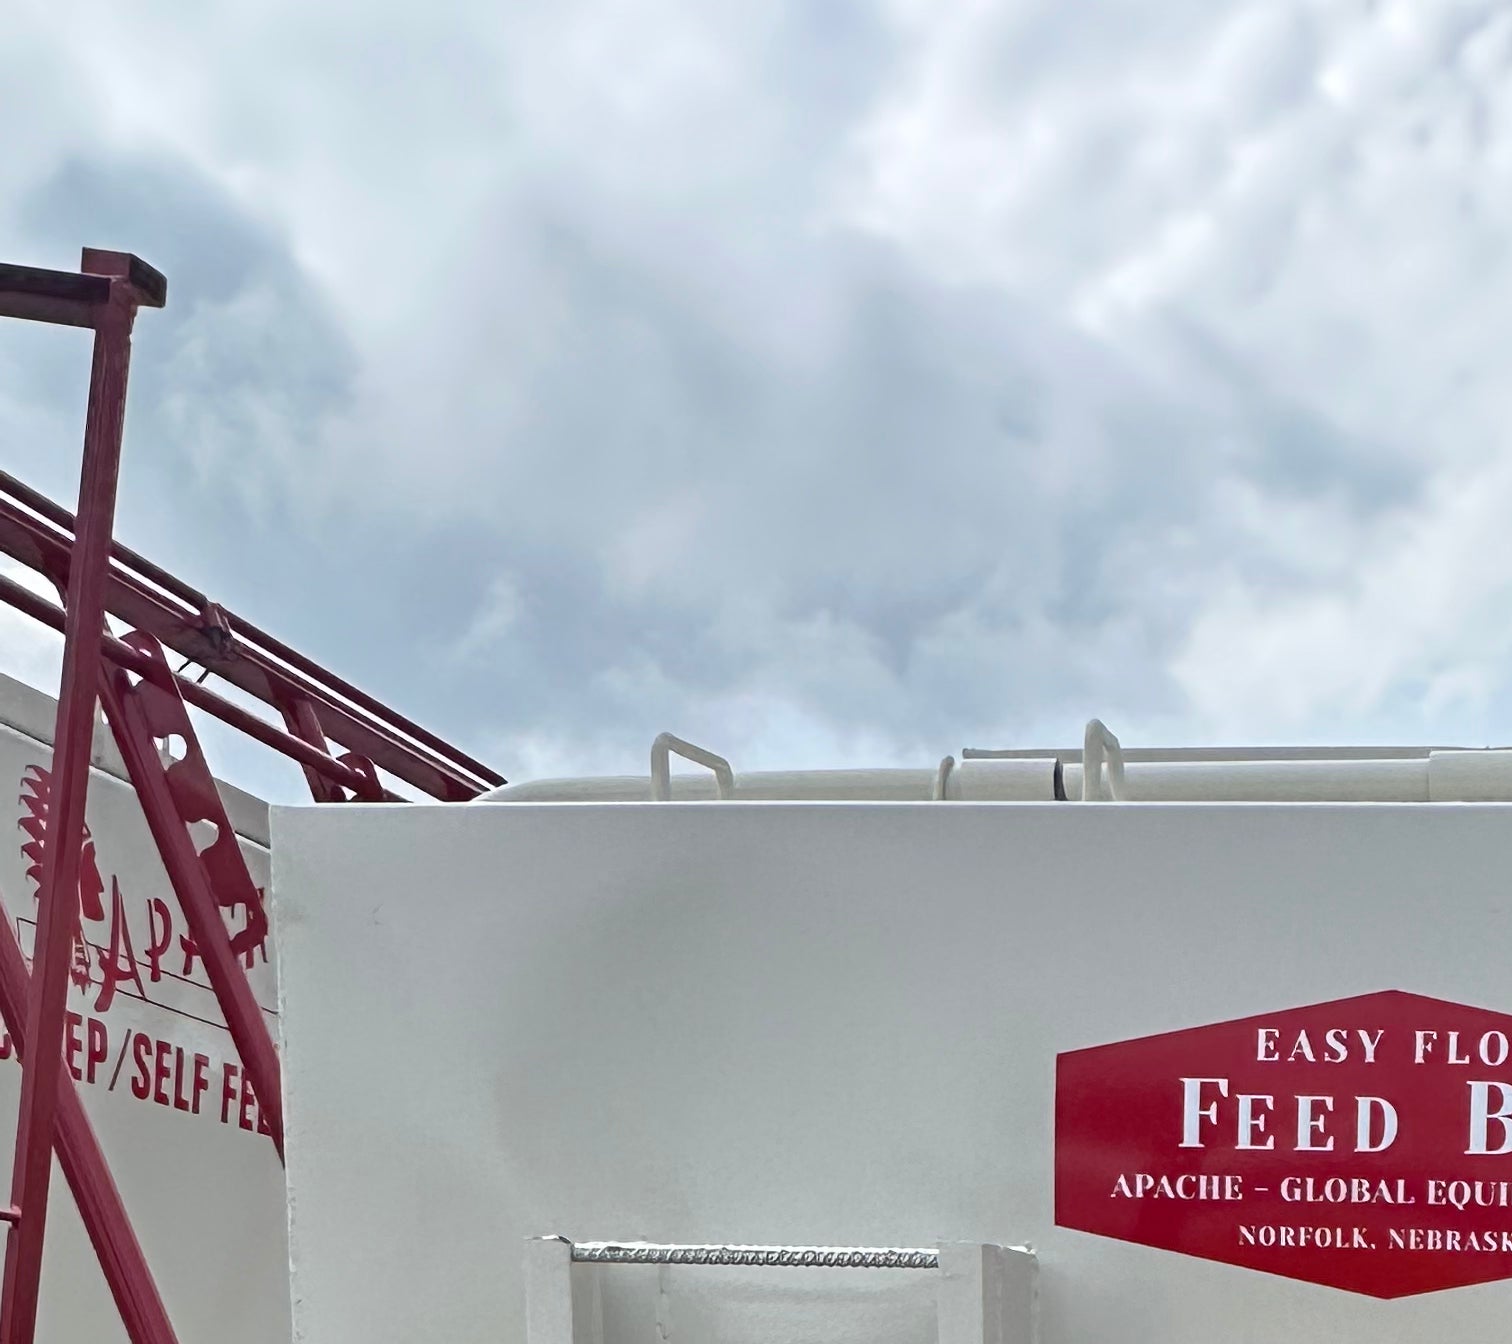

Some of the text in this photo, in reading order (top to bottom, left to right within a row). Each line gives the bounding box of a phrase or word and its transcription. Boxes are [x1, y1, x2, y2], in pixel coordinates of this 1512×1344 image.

[1257, 1028, 1384, 1064] EASY
[1110, 1173, 1243, 1200] APACHE
[1280, 1176, 1415, 1204] GLOBAL
[1239, 1225, 1376, 1250] NORFOLK,
